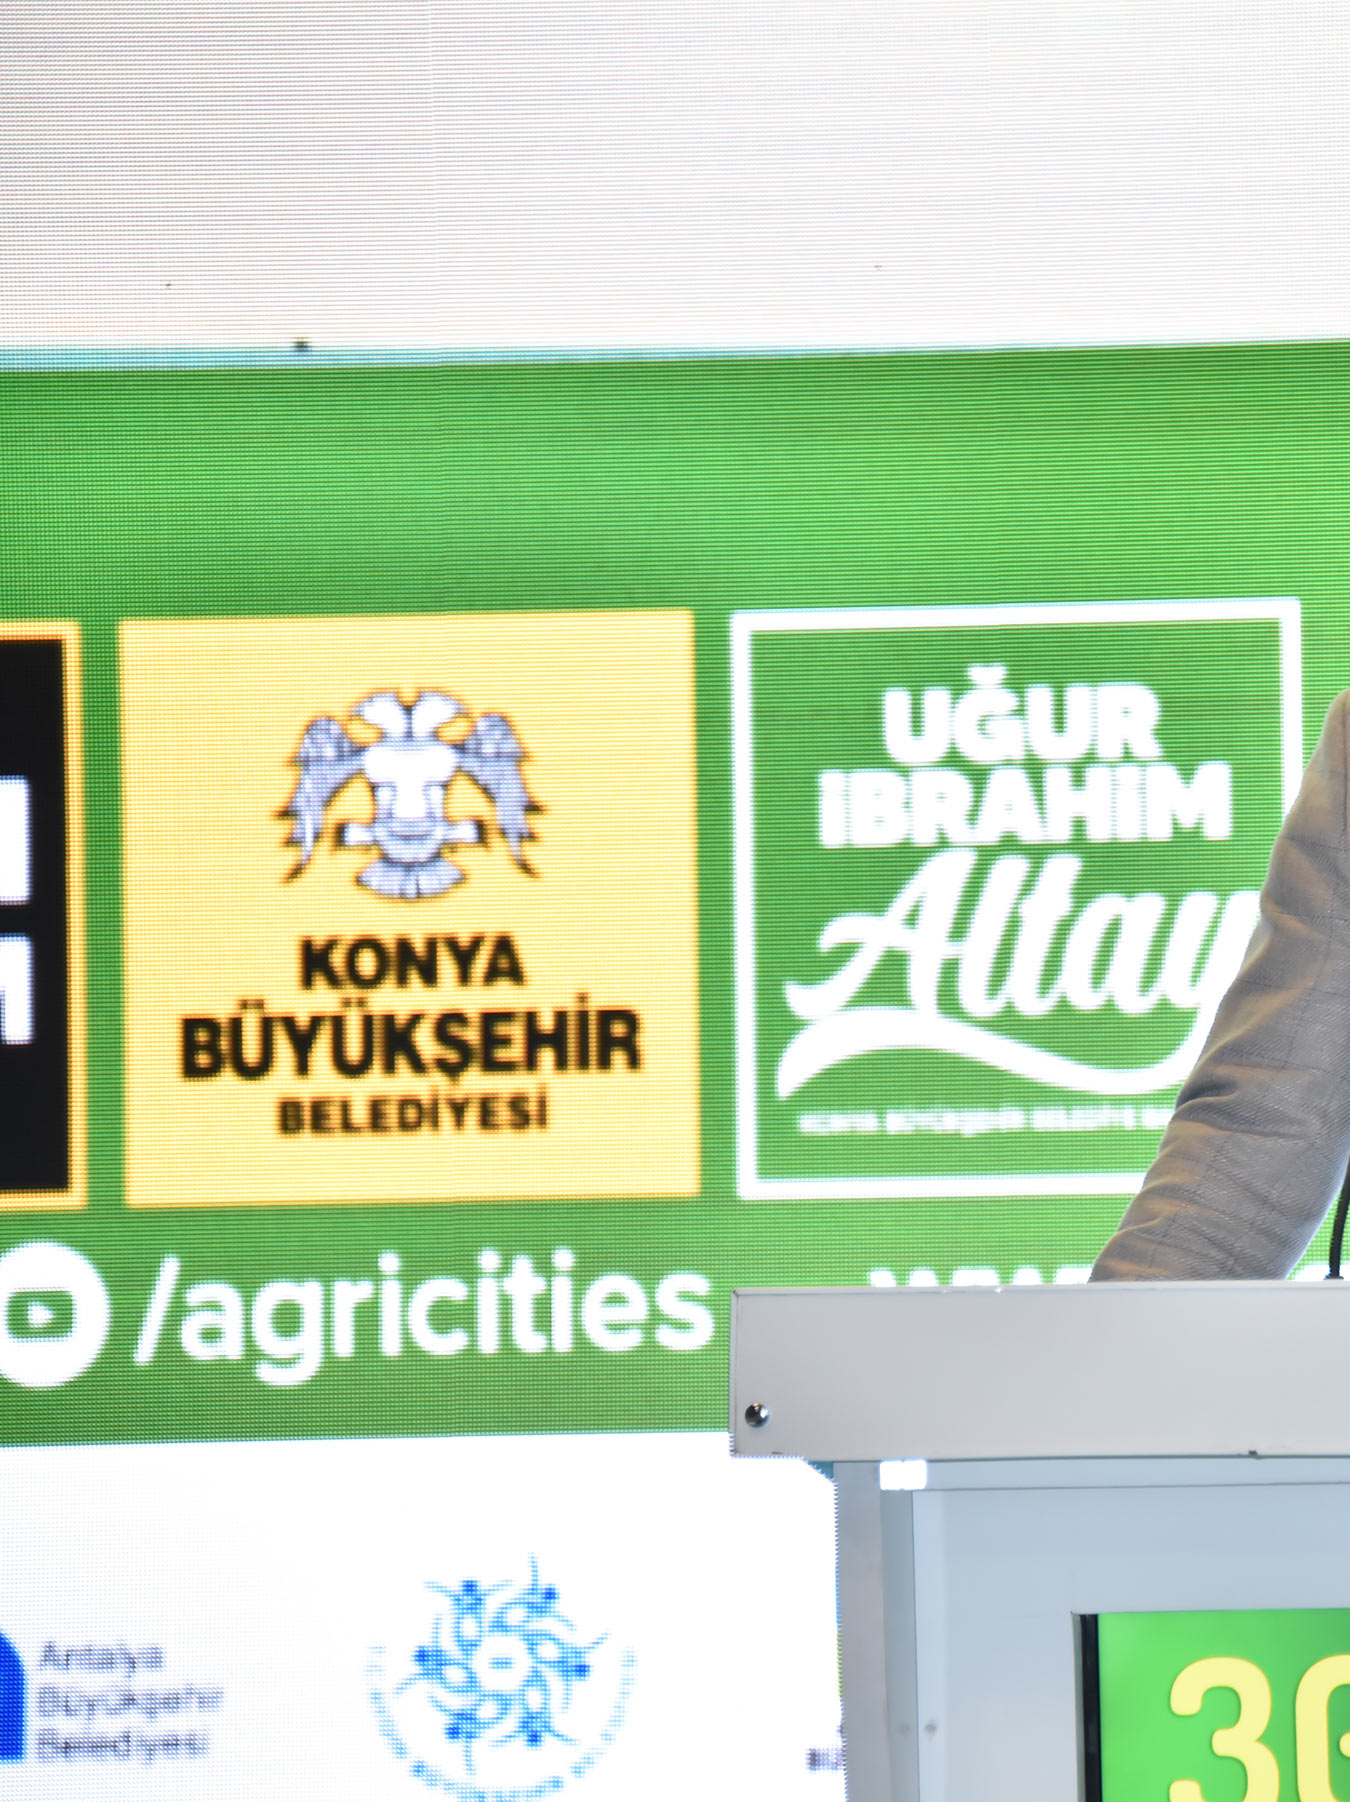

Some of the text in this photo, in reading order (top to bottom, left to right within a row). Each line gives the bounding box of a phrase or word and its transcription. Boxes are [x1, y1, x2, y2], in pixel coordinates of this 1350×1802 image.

[883, 664, 1162, 766] UĞUR
[301, 937, 526, 990] KONYA
[181, 992, 642, 1083] BÜYÜKŞEHİR
[278, 1084, 547, 1136] BELEDİYESİ
[134, 1246, 714, 1386] /agricities
